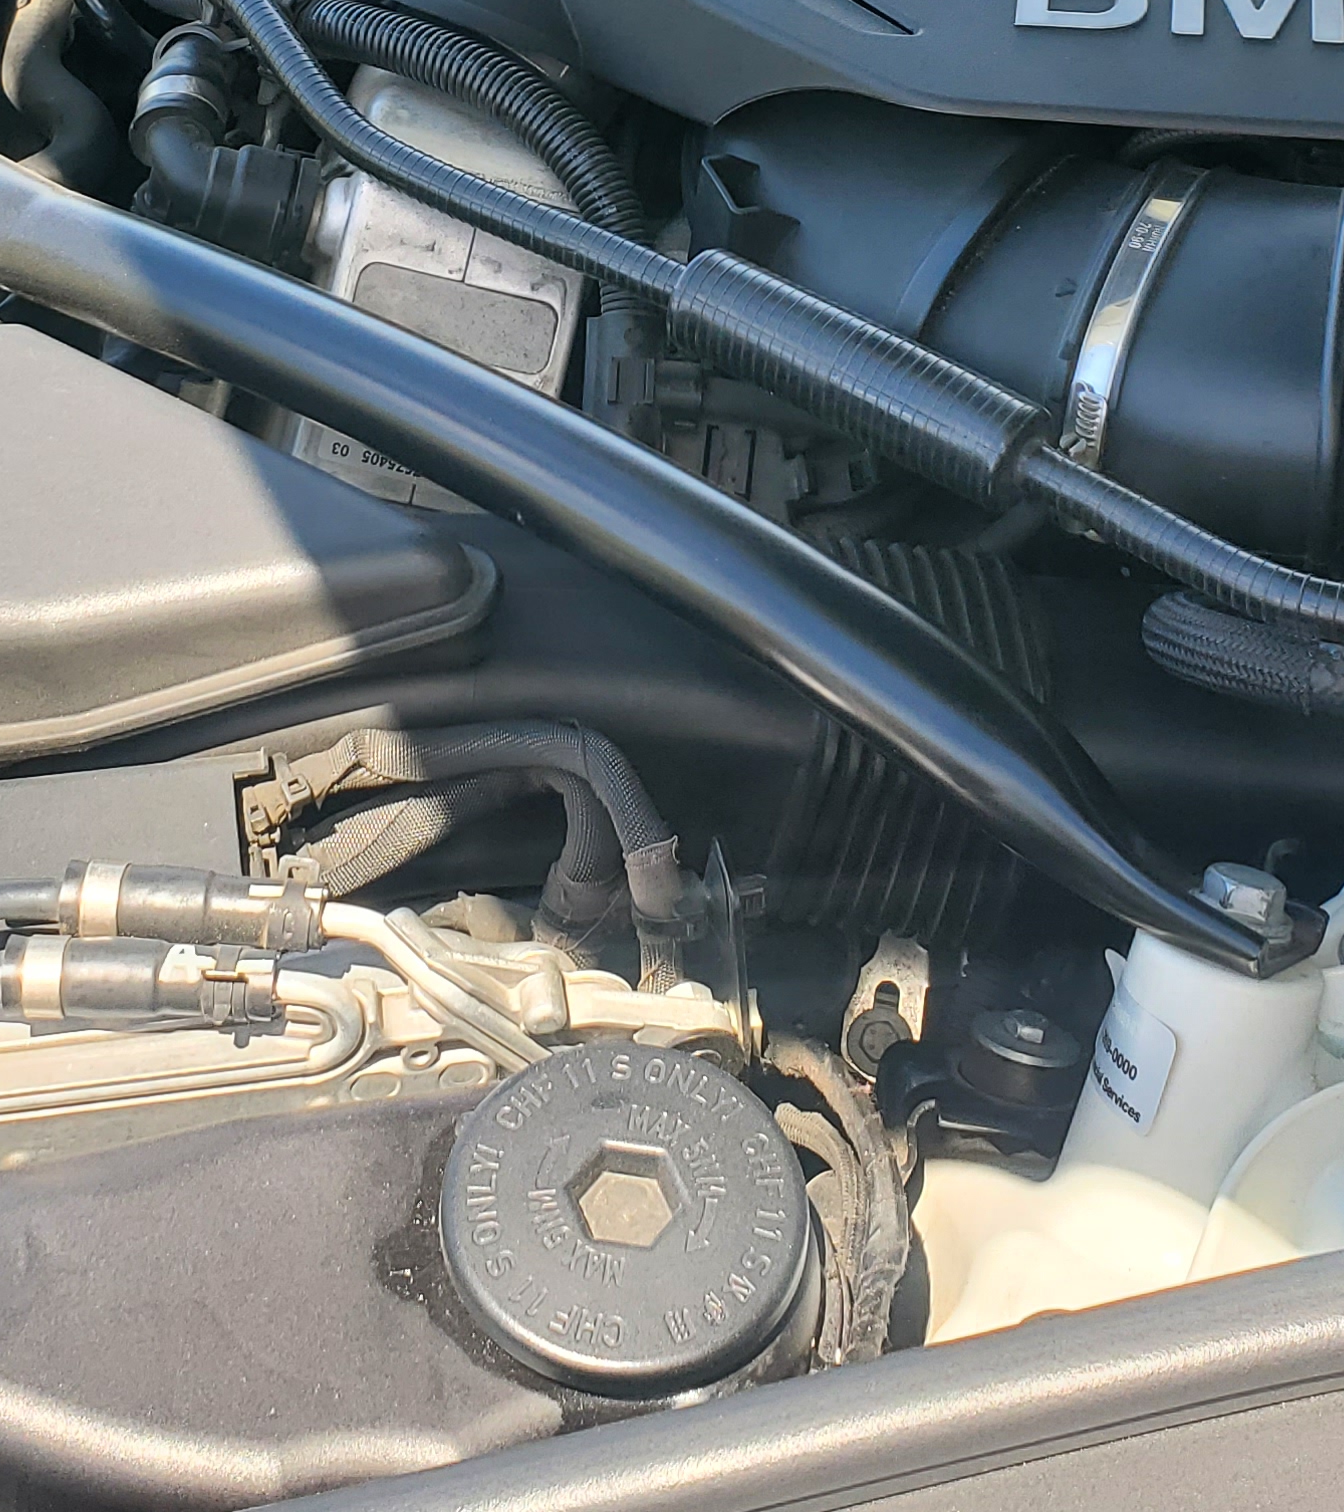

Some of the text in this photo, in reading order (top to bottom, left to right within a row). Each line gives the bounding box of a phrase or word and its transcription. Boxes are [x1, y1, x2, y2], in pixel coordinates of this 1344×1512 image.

[331, 442, 350, 457] 03
[496, 1075, 553, 1132] CHF
[610, 1053, 631, 1081] S
[1102, 1077, 1141, 1123] Services
[627, 1103, 694, 1147] MAX
[742, 1132, 785, 1199] CHF
[485, 1248, 515, 1278] S
[559, 1239, 626, 1287] MAX
[547, 1309, 626, 1348] CHF
